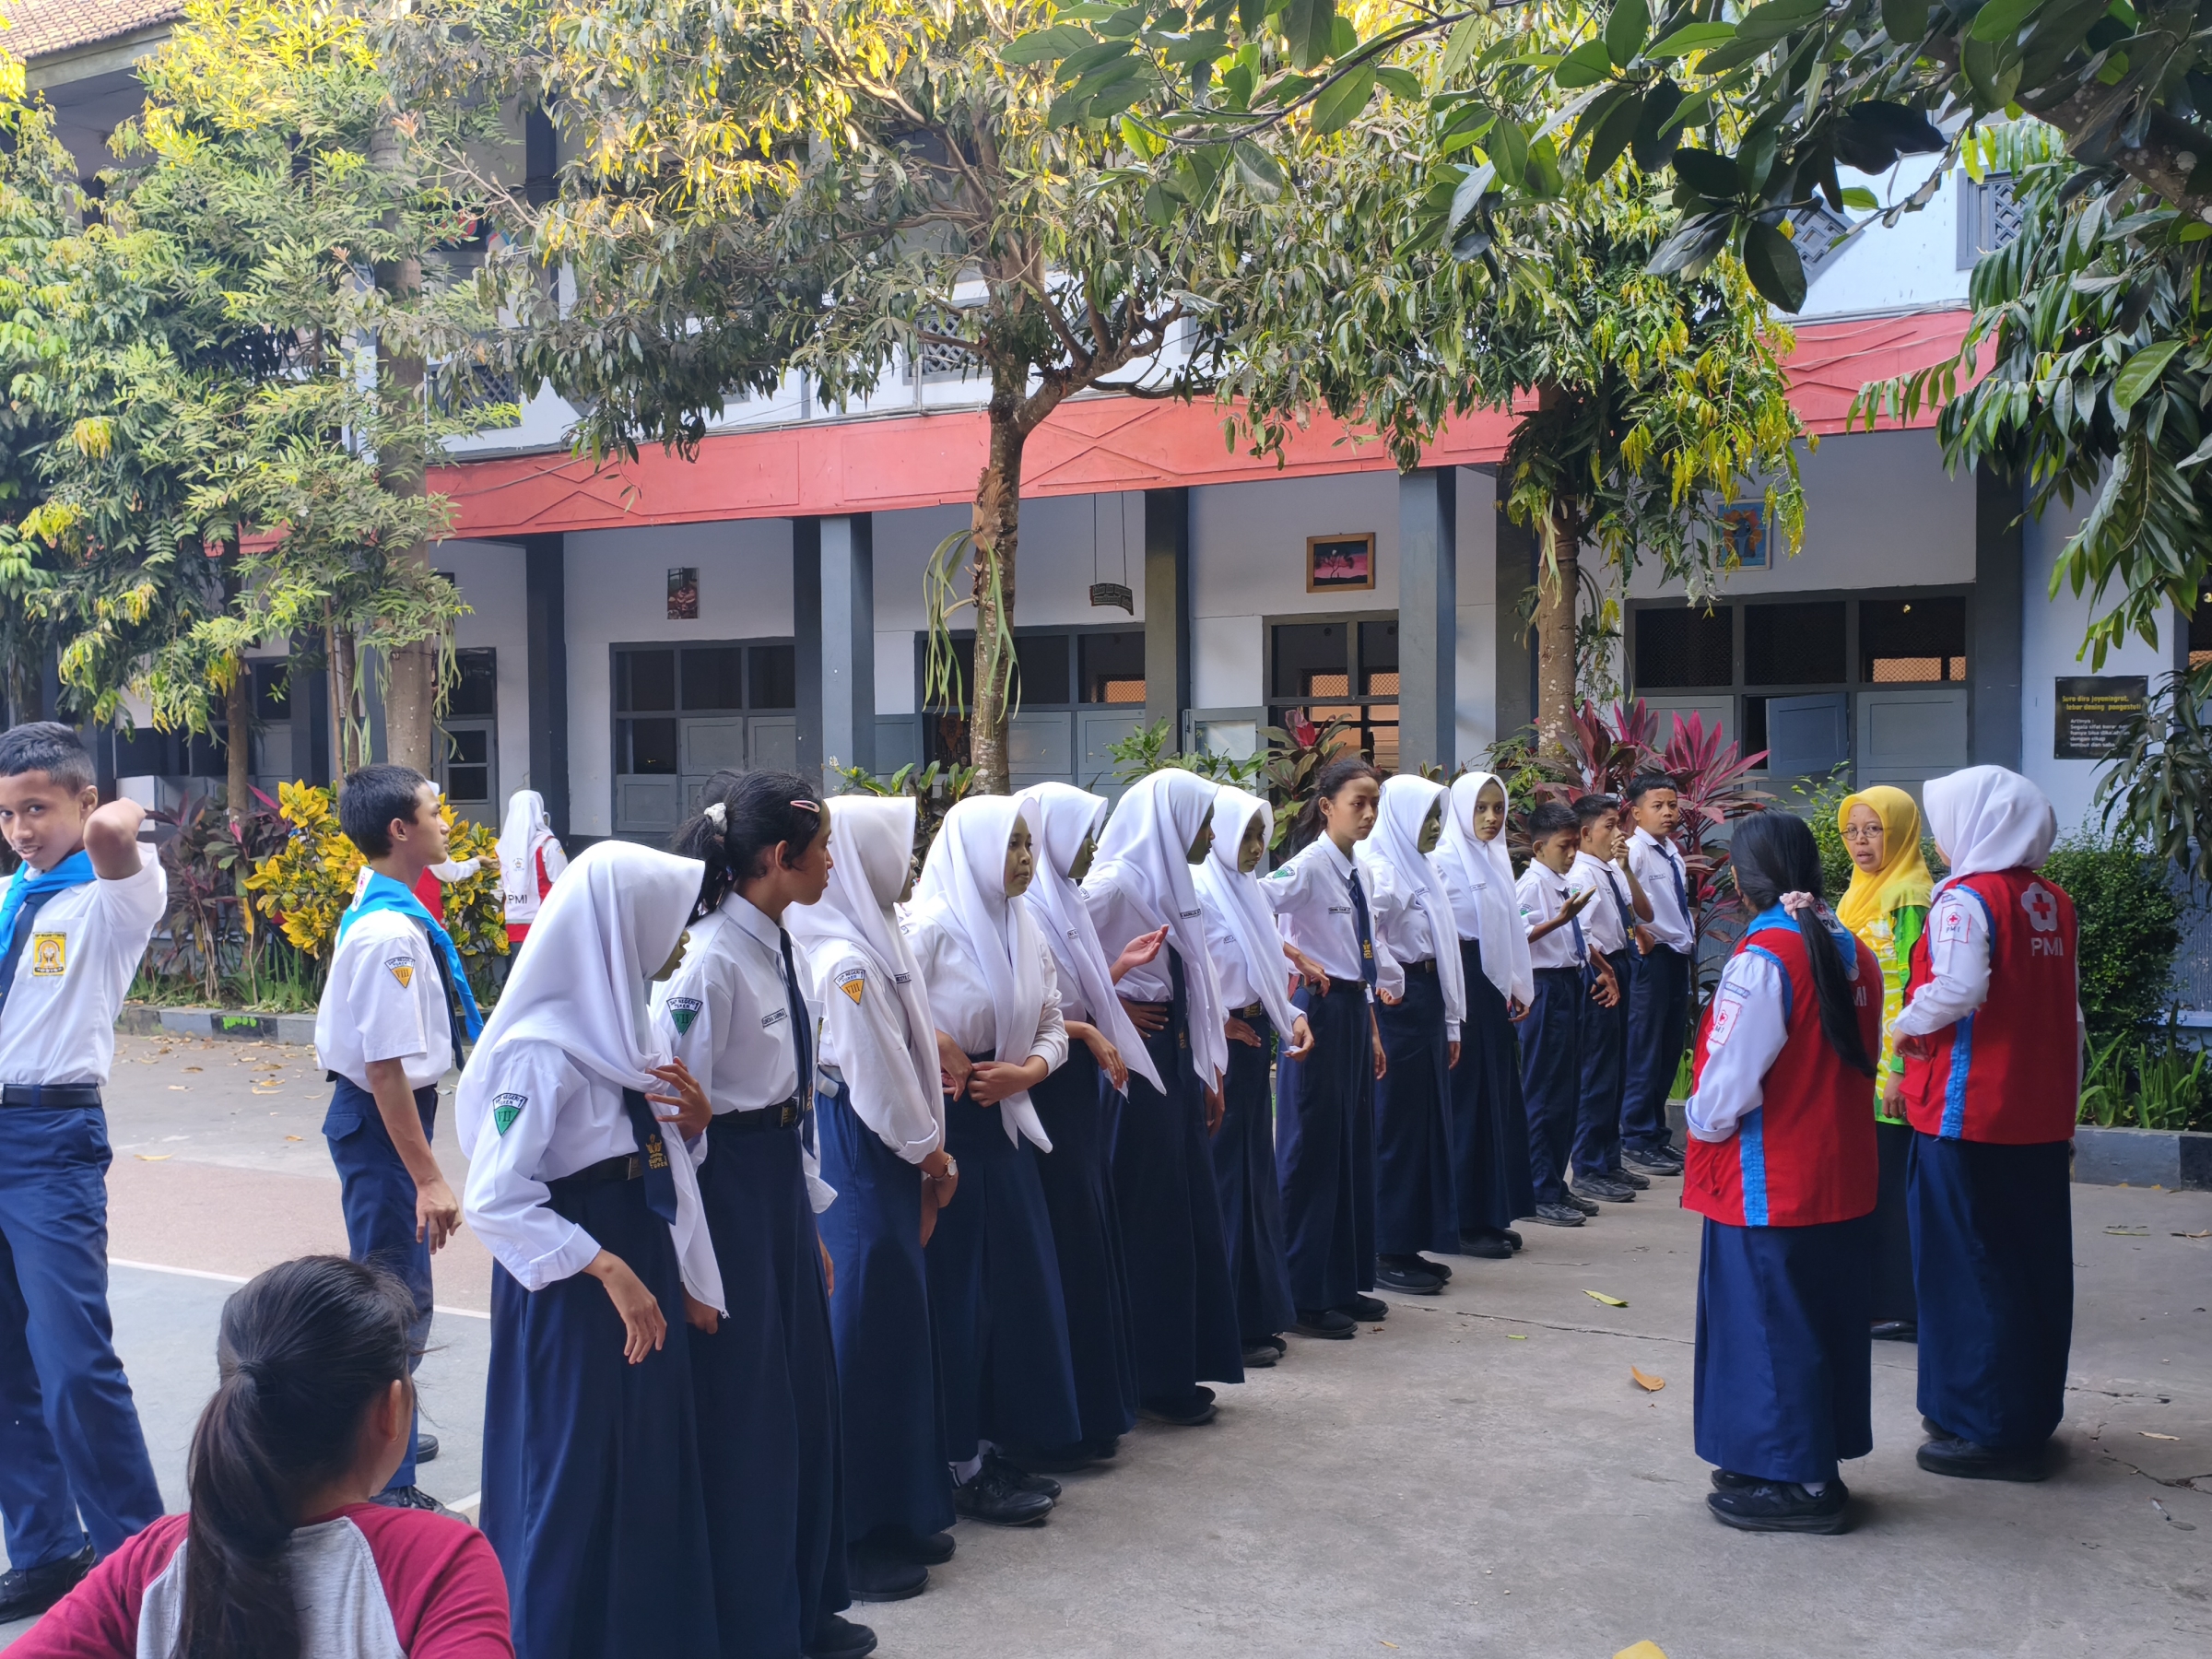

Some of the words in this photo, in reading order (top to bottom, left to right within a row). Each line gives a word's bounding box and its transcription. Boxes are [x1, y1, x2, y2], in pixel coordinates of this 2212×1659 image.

[508, 894, 527, 904] PMI
[2030, 936, 2064, 957] PMI
[395, 969, 409, 979] VIII
[845, 982, 861, 994] VIII
[498, 1110, 512, 1123] VII
